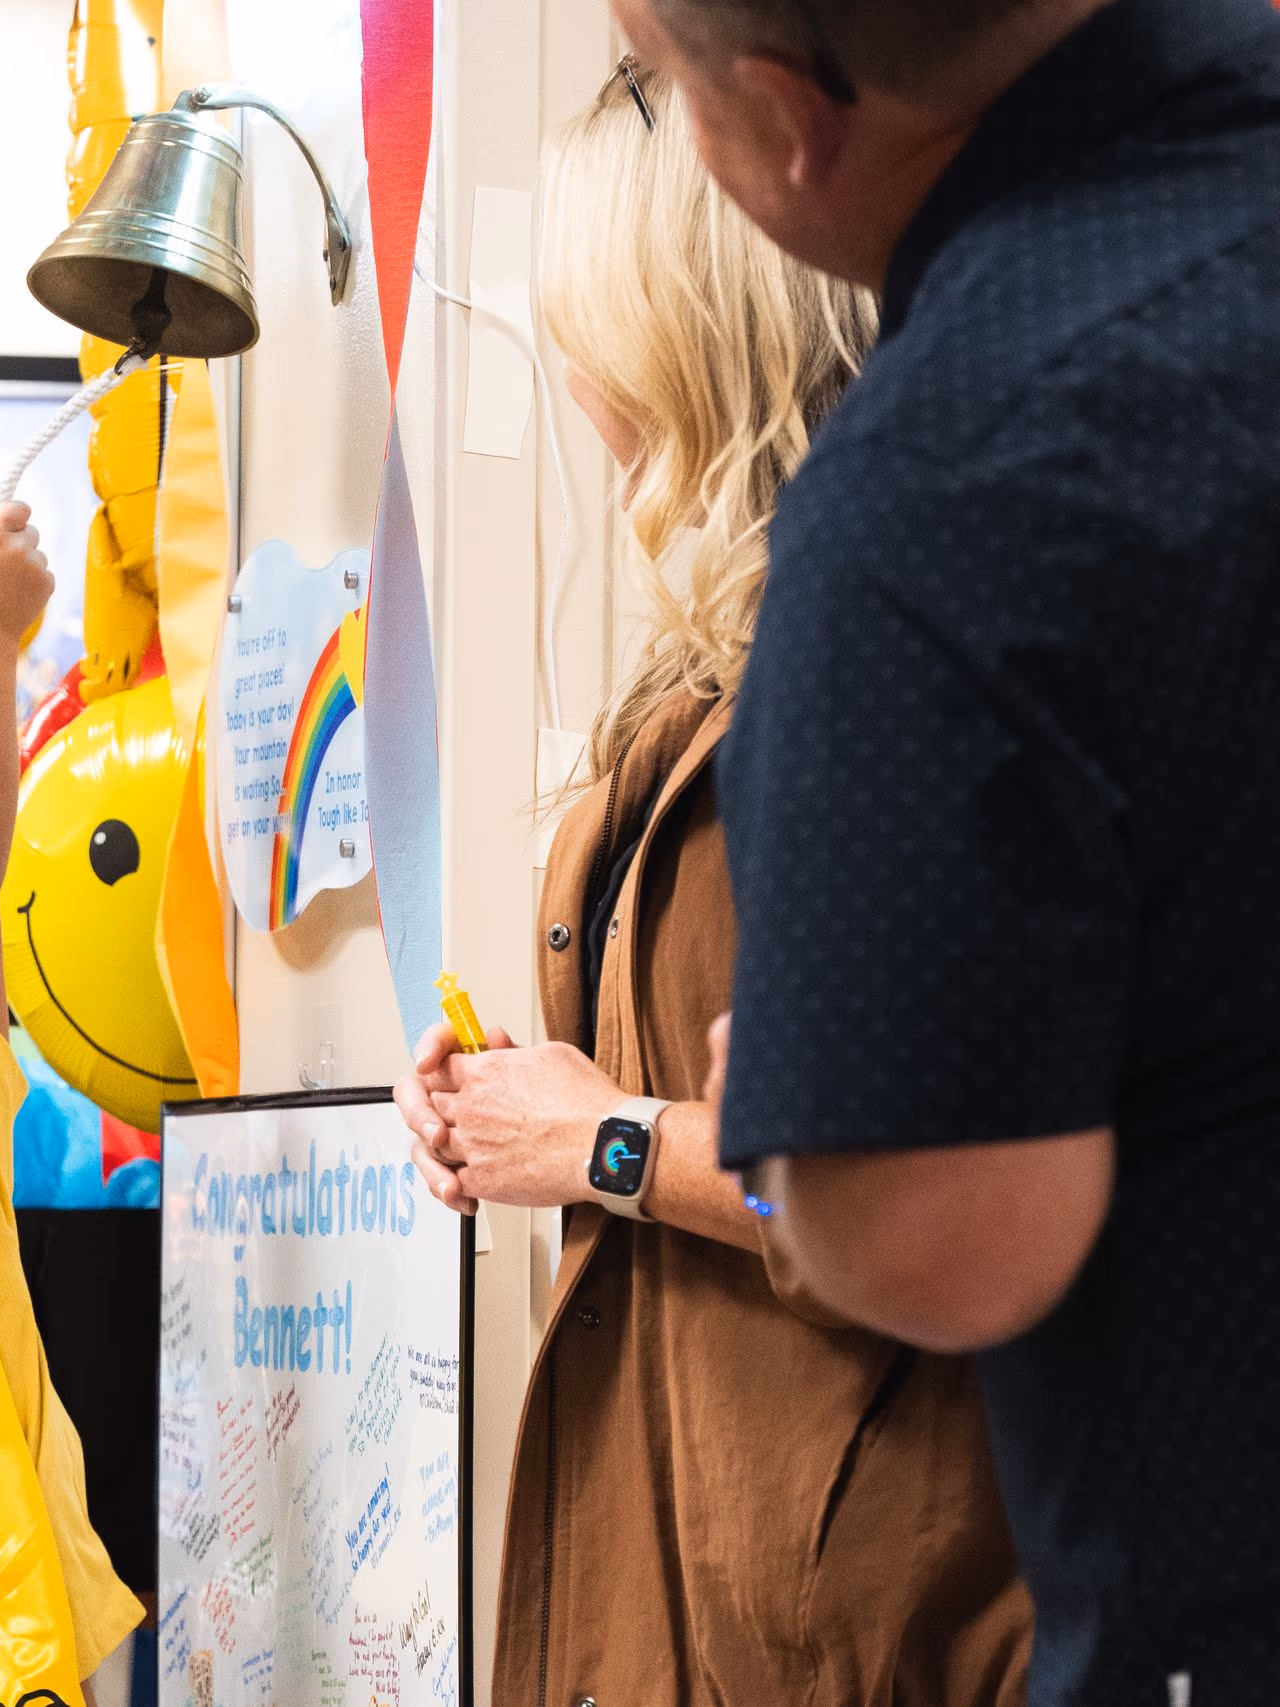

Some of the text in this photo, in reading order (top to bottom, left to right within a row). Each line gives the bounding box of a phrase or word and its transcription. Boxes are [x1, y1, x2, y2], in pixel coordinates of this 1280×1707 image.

[262, 626, 275, 652] off
[277, 628, 287, 649] to
[235, 660, 286, 700] great places!
[226, 697, 295, 734] Today is your day!
[234, 737, 288, 766] Your mountain
[242, 777, 270, 803] waiting
[325, 769, 362, 794] In honor
[226, 819, 240, 844] get
[241, 819, 252, 837] on
[253, 812, 271, 839] your
[318, 806, 341, 832] Tough
[343, 801, 358, 825] like
[192, 1138, 416, 1262] Congratulations
[234, 1275, 353, 1376] Bennett!
